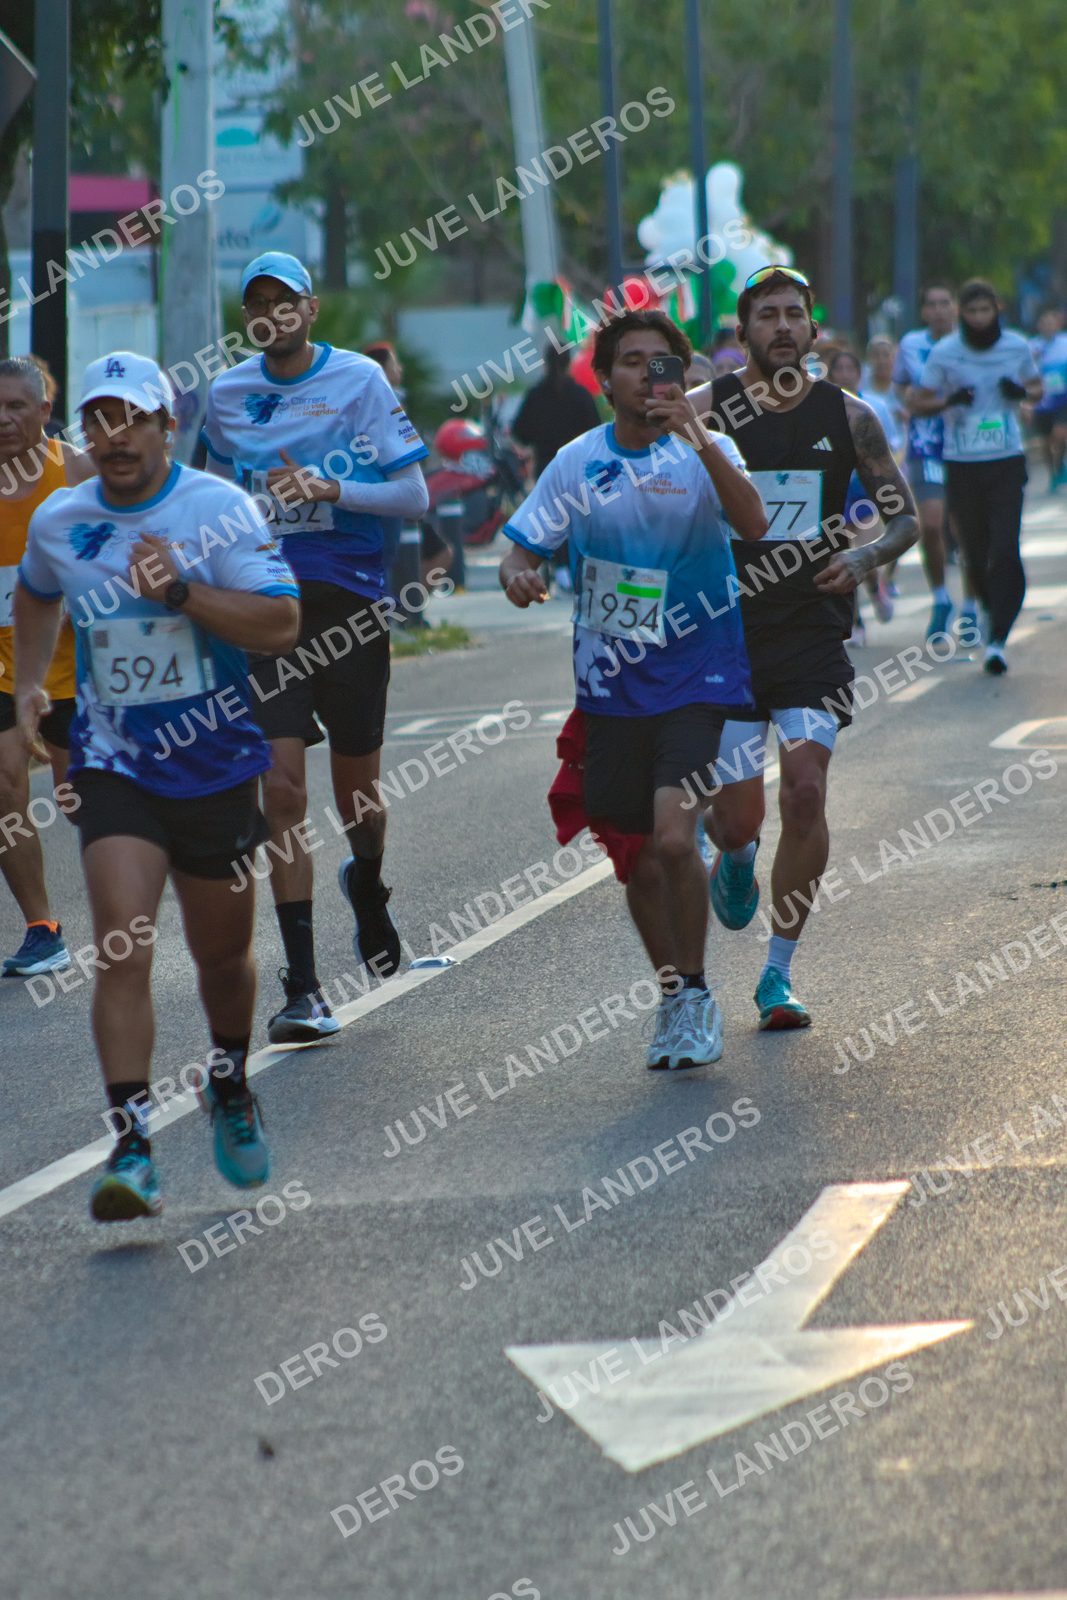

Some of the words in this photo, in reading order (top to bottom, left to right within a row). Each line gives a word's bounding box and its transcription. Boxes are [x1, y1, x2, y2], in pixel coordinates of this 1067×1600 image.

[104, 358, 125, 378] LA
[586, 588, 660, 633] 1954
[108, 653, 184, 695] 594
